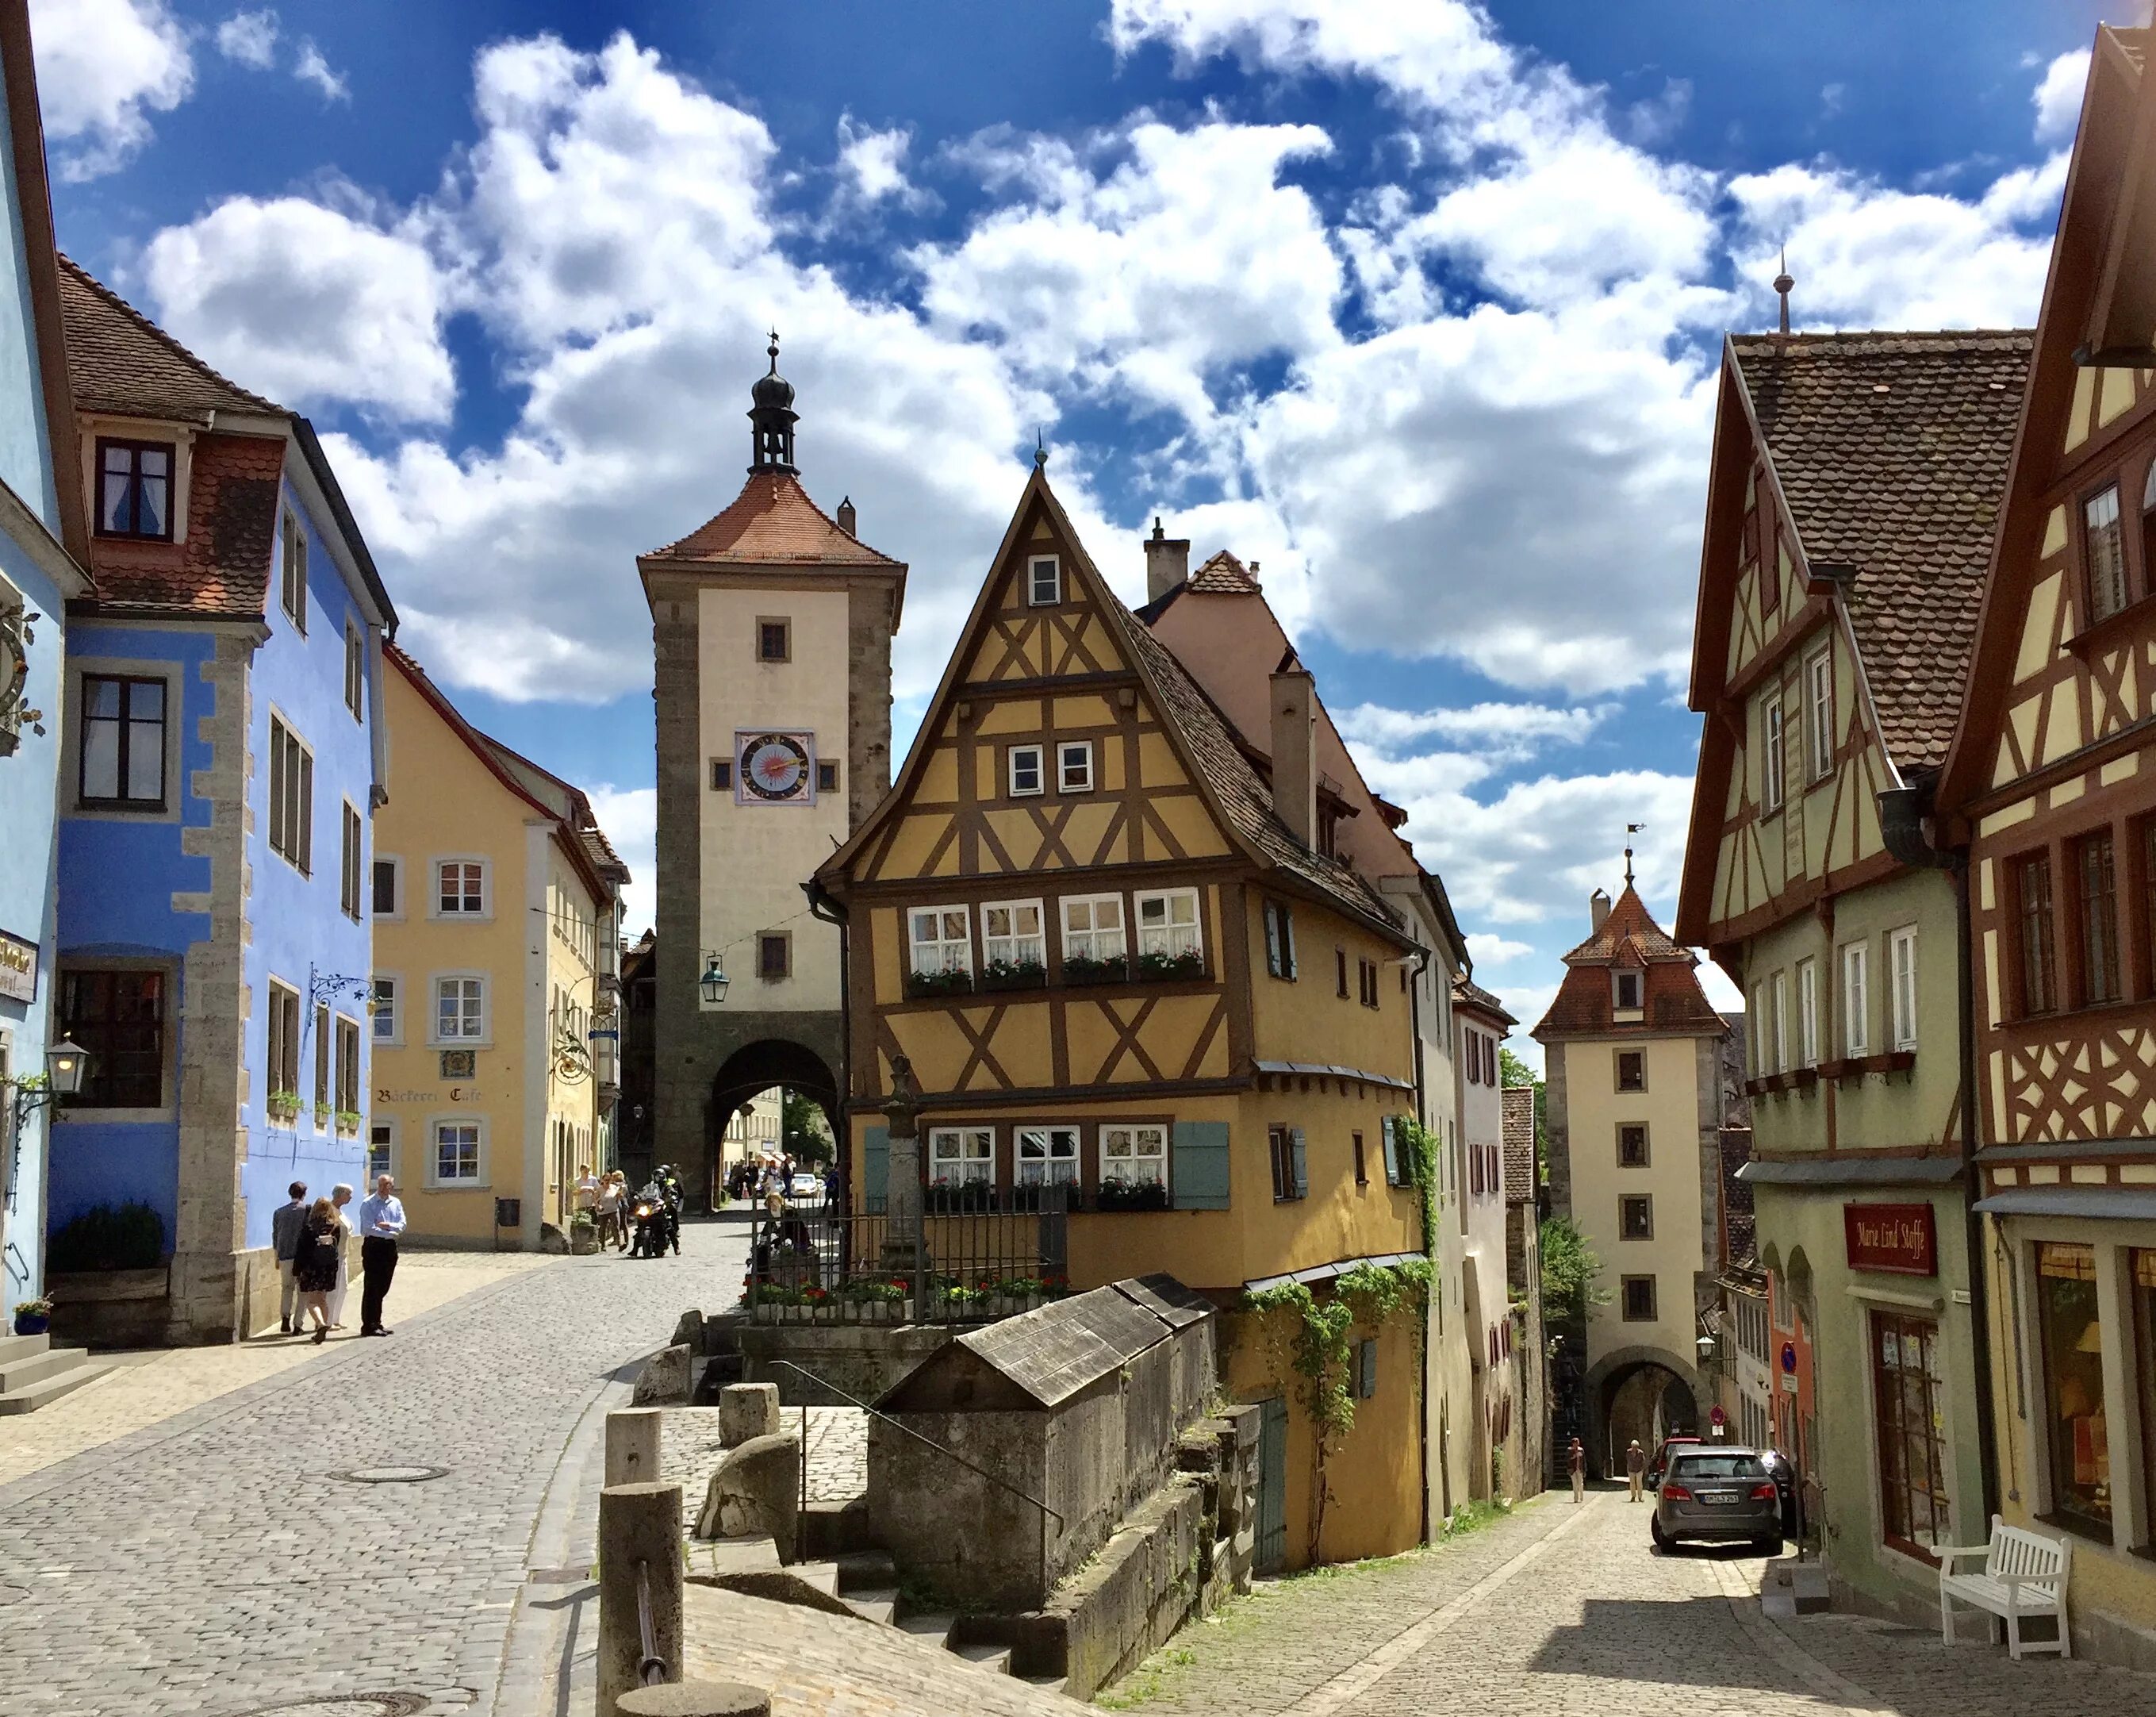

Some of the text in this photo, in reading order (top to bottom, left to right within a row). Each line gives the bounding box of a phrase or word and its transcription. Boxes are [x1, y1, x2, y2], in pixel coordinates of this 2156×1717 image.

[1857, 1219, 1924, 1260] Marie Lind Stoffe
